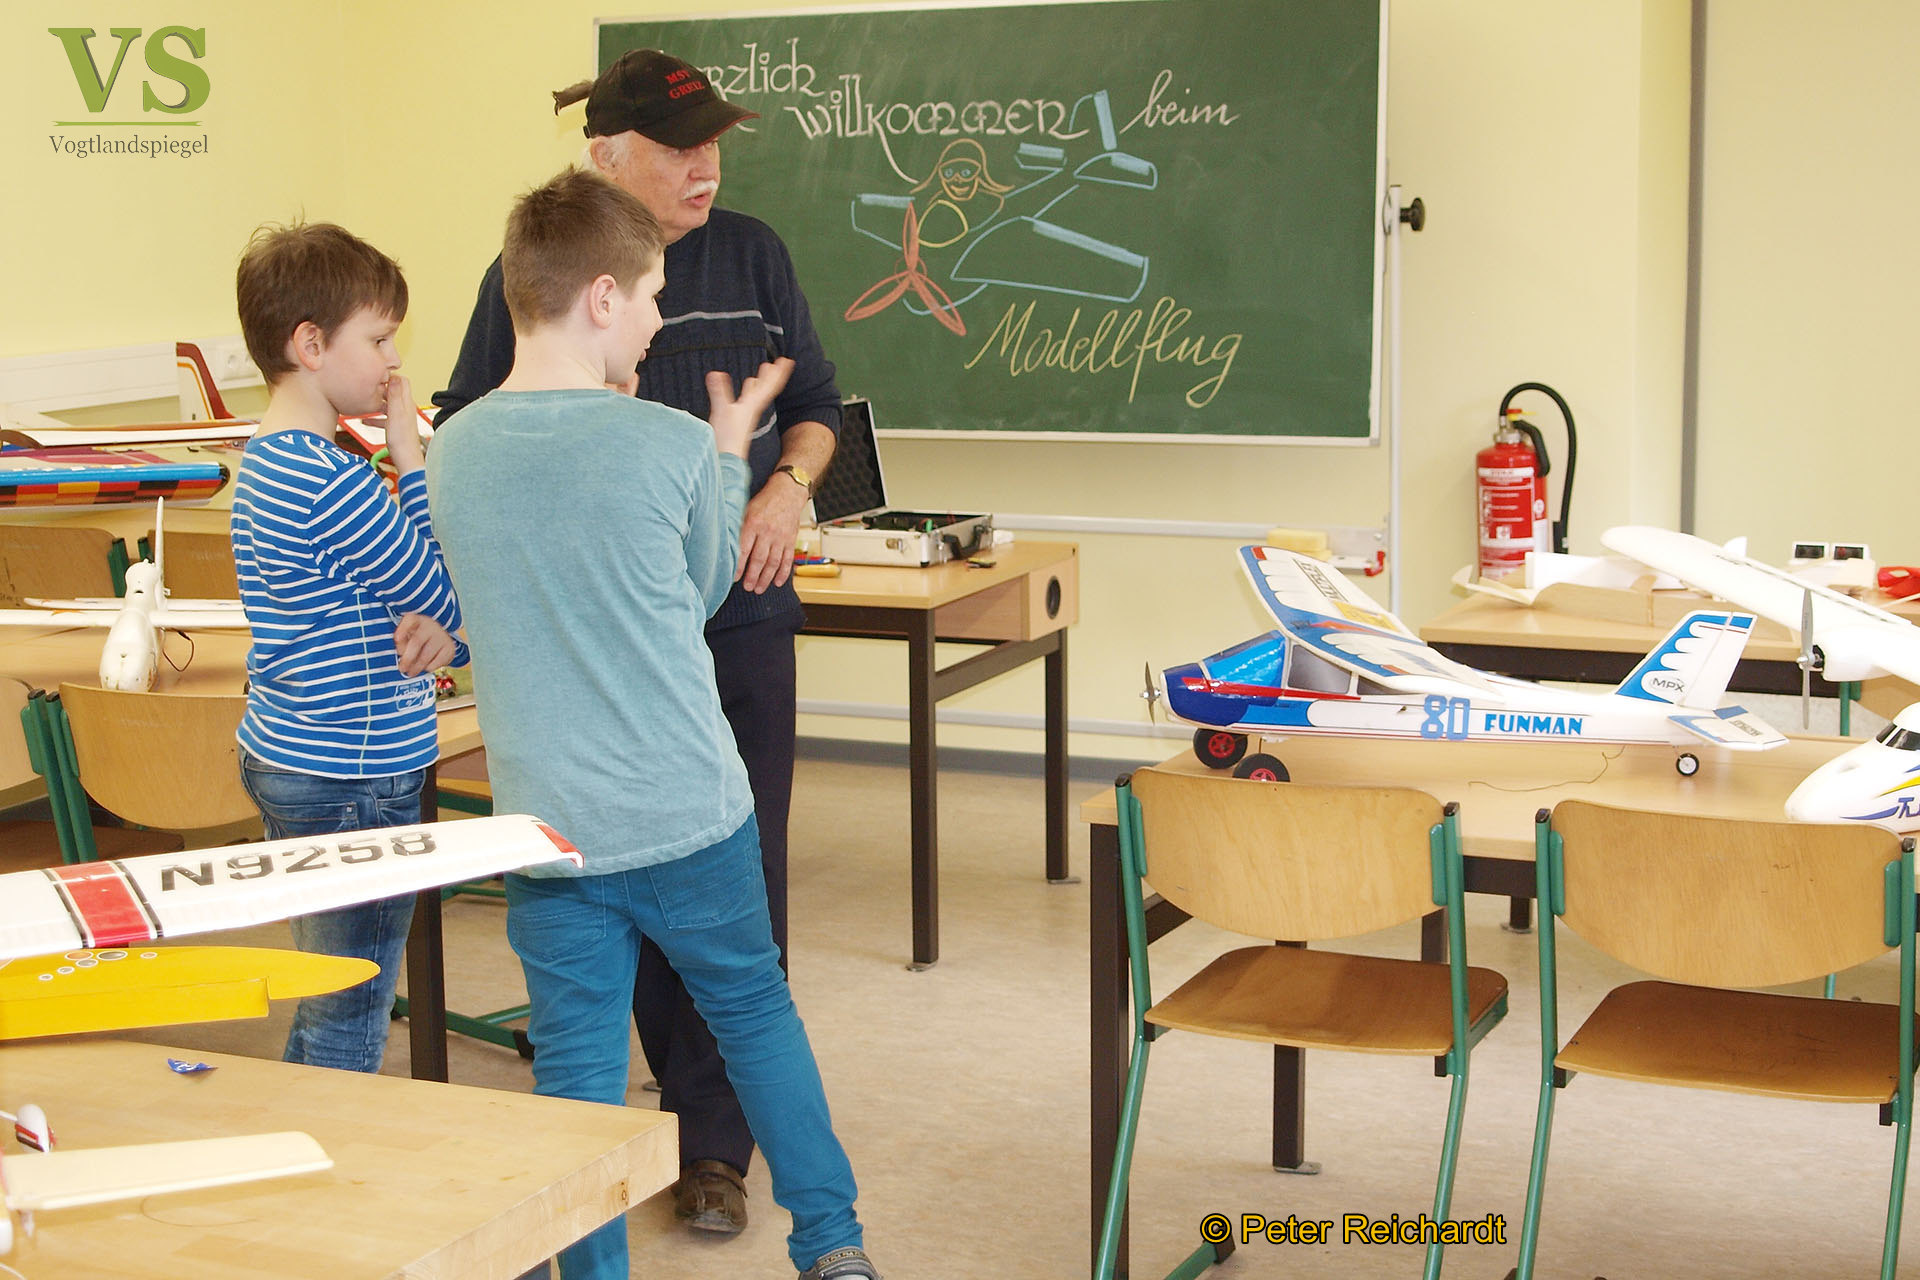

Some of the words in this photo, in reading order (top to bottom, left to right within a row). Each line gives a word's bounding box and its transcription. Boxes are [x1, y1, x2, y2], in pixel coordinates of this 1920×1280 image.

[697, 37, 825, 131] rzlich
[784, 74, 1089, 183] willkommen
[1119, 69, 1240, 134] beim
[964, 296, 1243, 408] Modellflug
[1653, 677, 1685, 693] MPX
[1421, 694, 1471, 741] 80
[1484, 713, 1583, 736] FUNMAN
[161, 831, 437, 891] N9258
